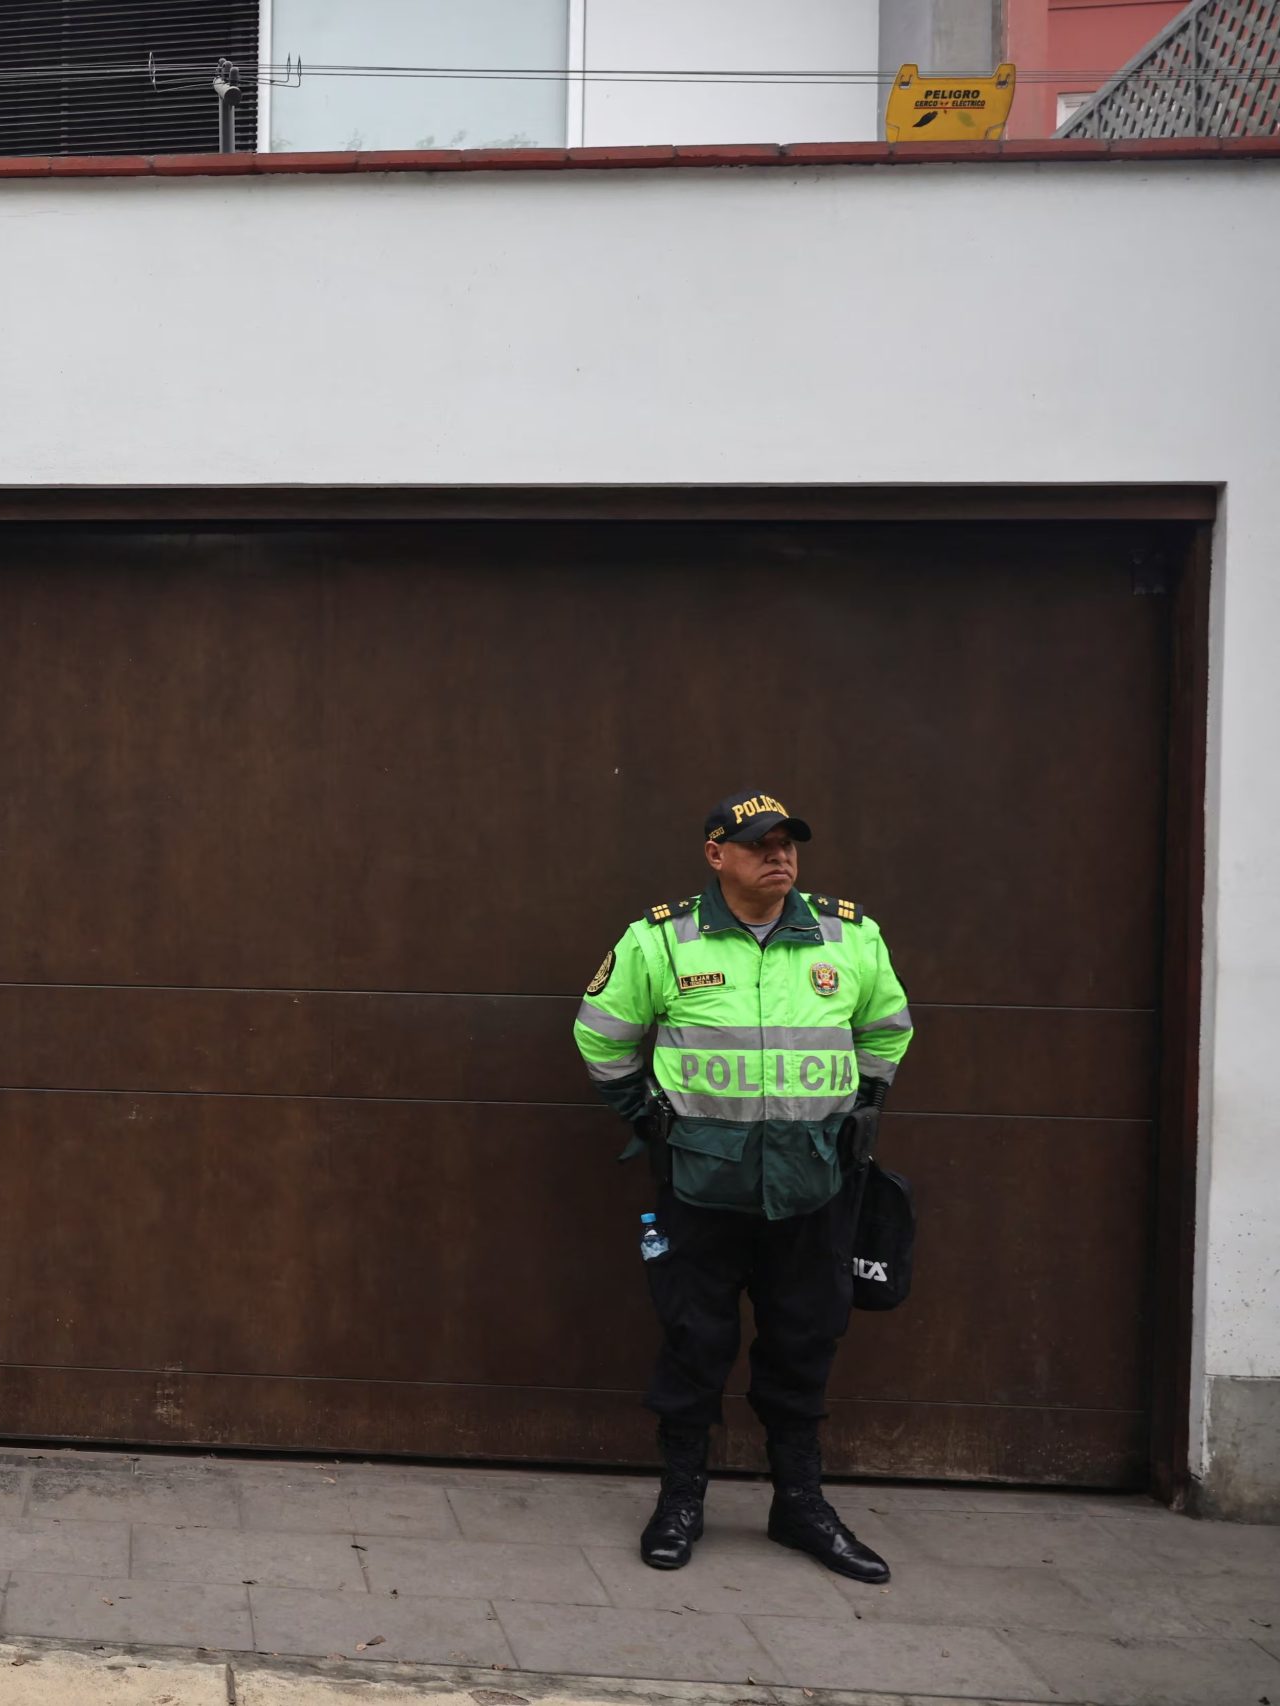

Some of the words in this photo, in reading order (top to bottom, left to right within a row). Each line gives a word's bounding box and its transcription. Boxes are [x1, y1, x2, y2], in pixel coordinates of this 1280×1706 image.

[923, 89, 981, 99] PELIGRO
[681, 1054, 853, 1091] POLICIA
[852, 1257, 887, 1281] ILA
